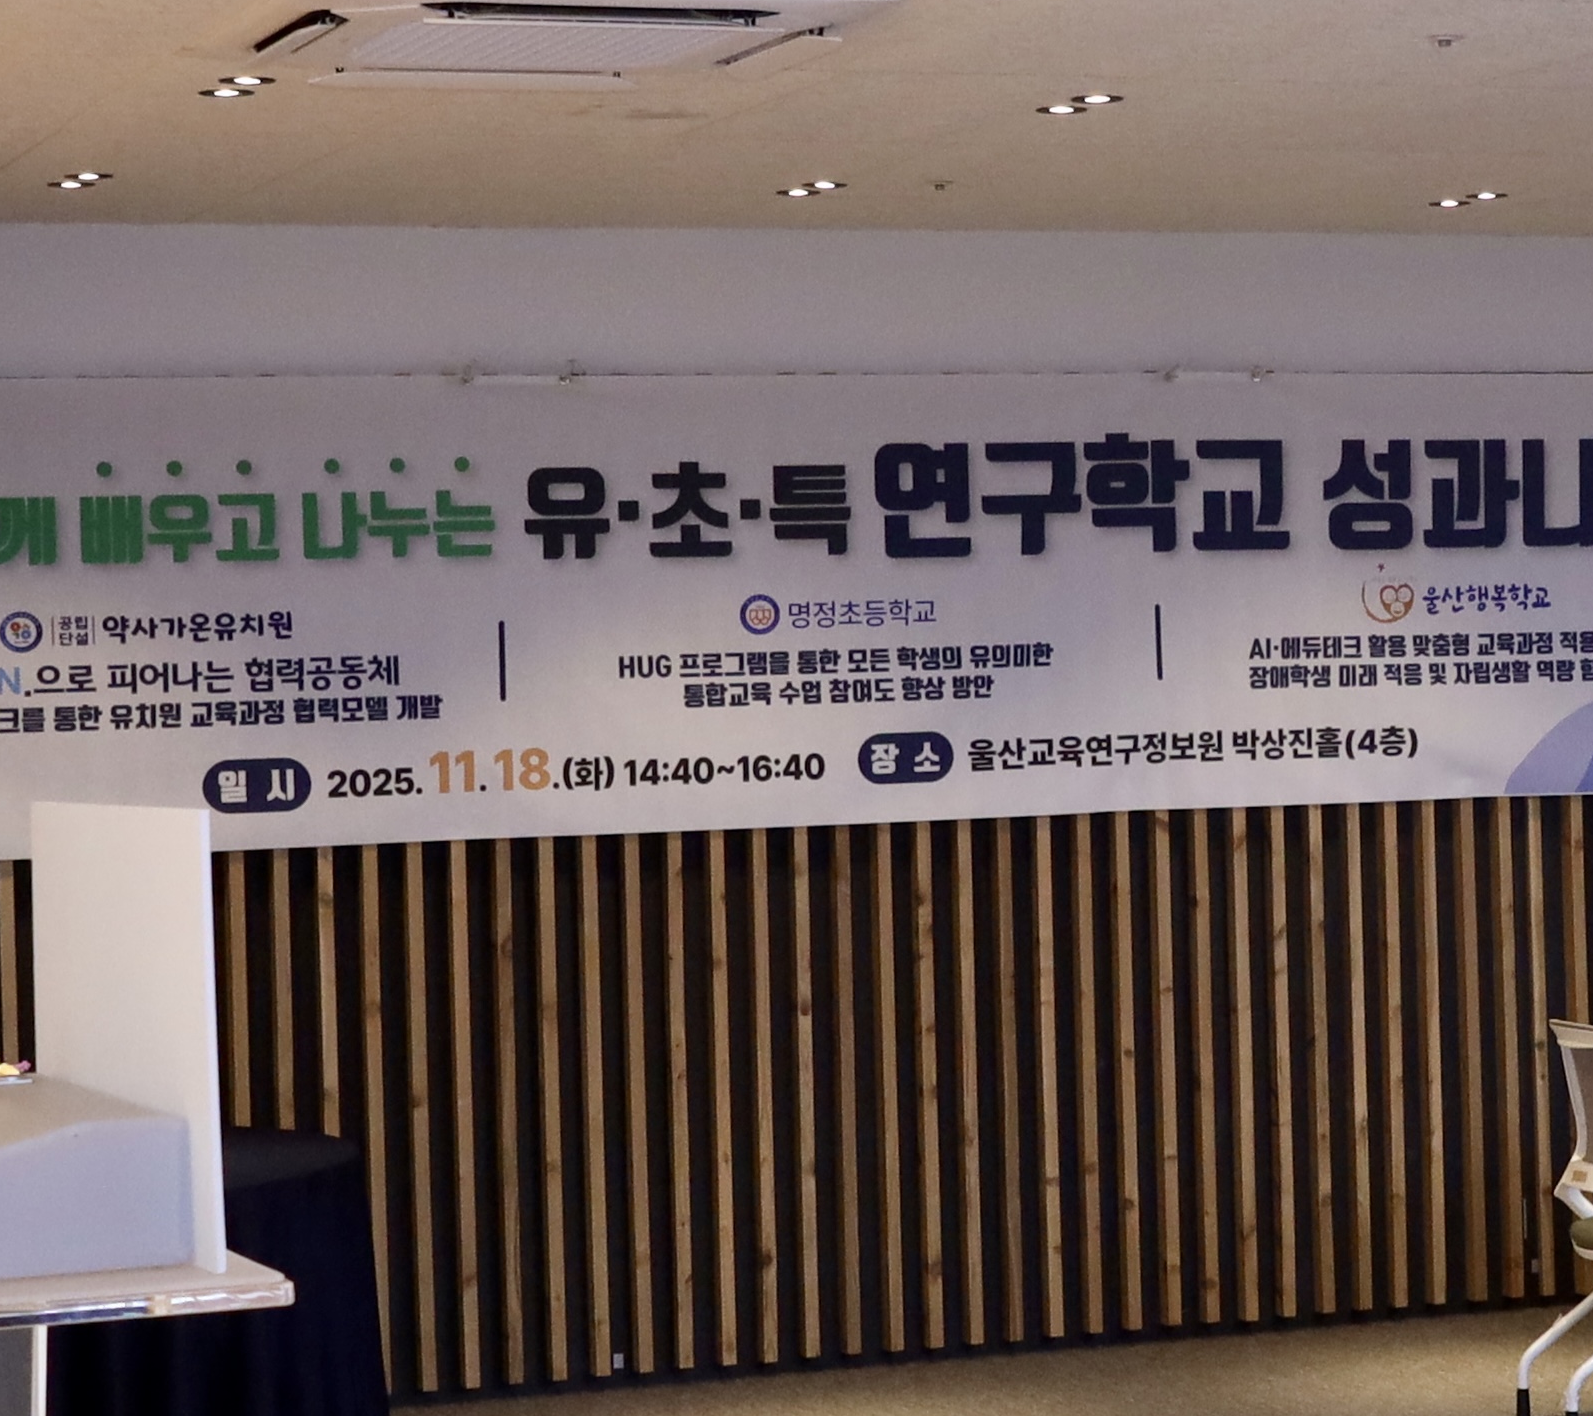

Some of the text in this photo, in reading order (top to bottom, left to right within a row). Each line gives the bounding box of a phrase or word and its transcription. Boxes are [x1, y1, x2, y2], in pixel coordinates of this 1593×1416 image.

[80, 494, 279, 565] 배우고
[302, 490, 495, 560] 나누는
[874, 433, 1290, 559] 연구학교
[789, 599, 936, 628] 명정초등학교
[1423, 584, 1551, 615] 울산행복학교
[59, 616, 88, 630] 공립
[59, 632, 88, 646] 단설
[103, 611, 292, 644] 약사가온유치원
[619, 642, 1053, 678] HUG 프로그램을 통한 모든 학생의 유의미한
[1368, 634, 1406, 657] 활용
[1413, 633, 1469, 656] 맞춤형
[1477, 632, 1553, 655] 교육과정
[108, 661, 234, 694] 피어나는
[245, 655, 400, 693] 협력공동체
[1250, 664, 1330, 689] 장애학생
[1339, 664, 1377, 687] 미래
[1384, 663, 1422, 685] 적응
[1429, 663, 1446, 685] 및
[1453, 660, 1531, 684] 자립생활
[1537, 660, 1575, 682] 역량
[684, 675, 994, 708] 통합교육 수업 참여도 향상 방안
[54, 705, 102, 732] 통한
[110, 703, 181, 729] 유치원
[191, 700, 284, 727] 교육과정
[293, 696, 388, 723] 협력모델
[396, 695, 443, 720] 개발
[968, 726, 1418, 771] 울산교육연구정보원 박상진홀(4층)
[624, 753, 825, 786] 14:40~16:40
